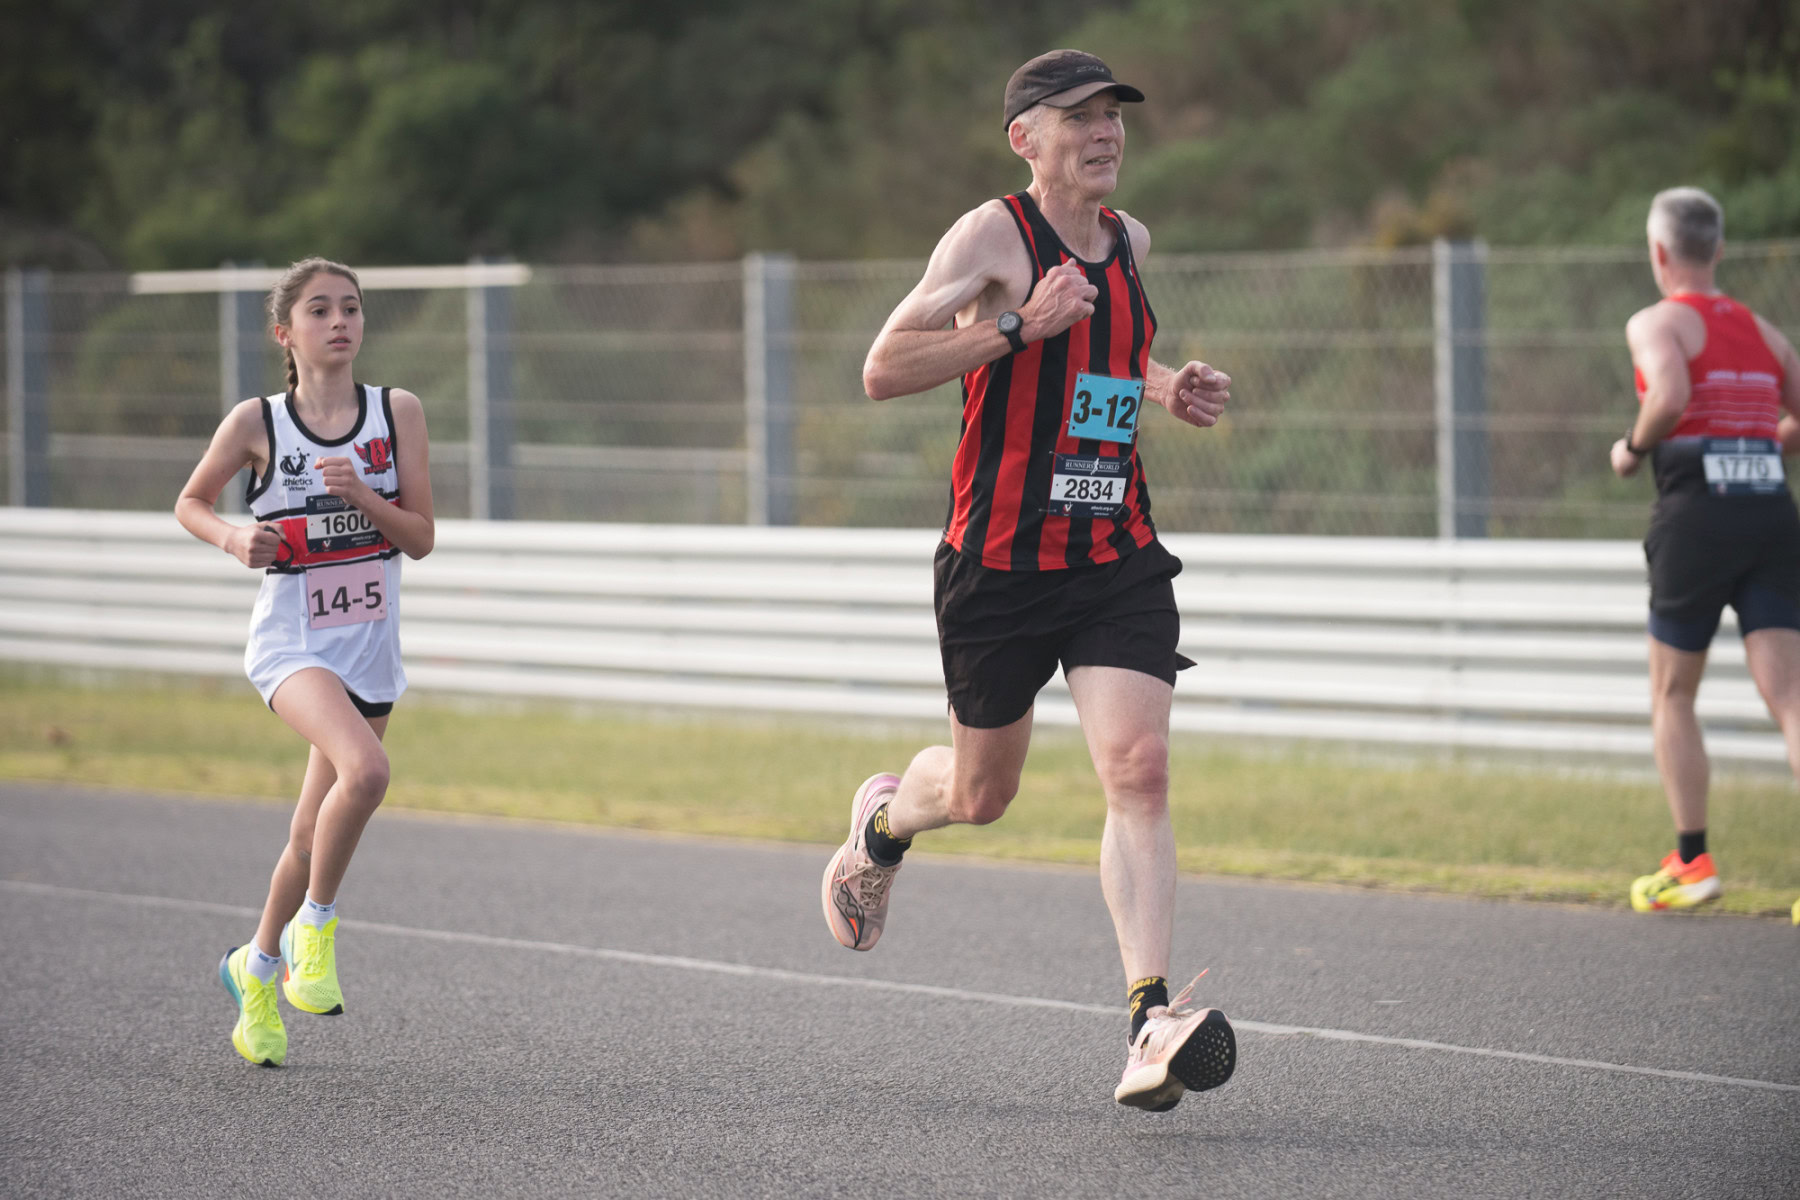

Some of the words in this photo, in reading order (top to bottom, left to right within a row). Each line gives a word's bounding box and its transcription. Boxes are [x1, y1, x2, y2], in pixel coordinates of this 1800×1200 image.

[1073, 390, 1137, 430] 3-12
[1718, 456, 1770, 482] 1770
[282, 477, 313, 487] thletics
[1064, 478, 1114, 501] 2834
[321, 513, 371, 535] 1600
[311, 581, 382, 617] 14-5
